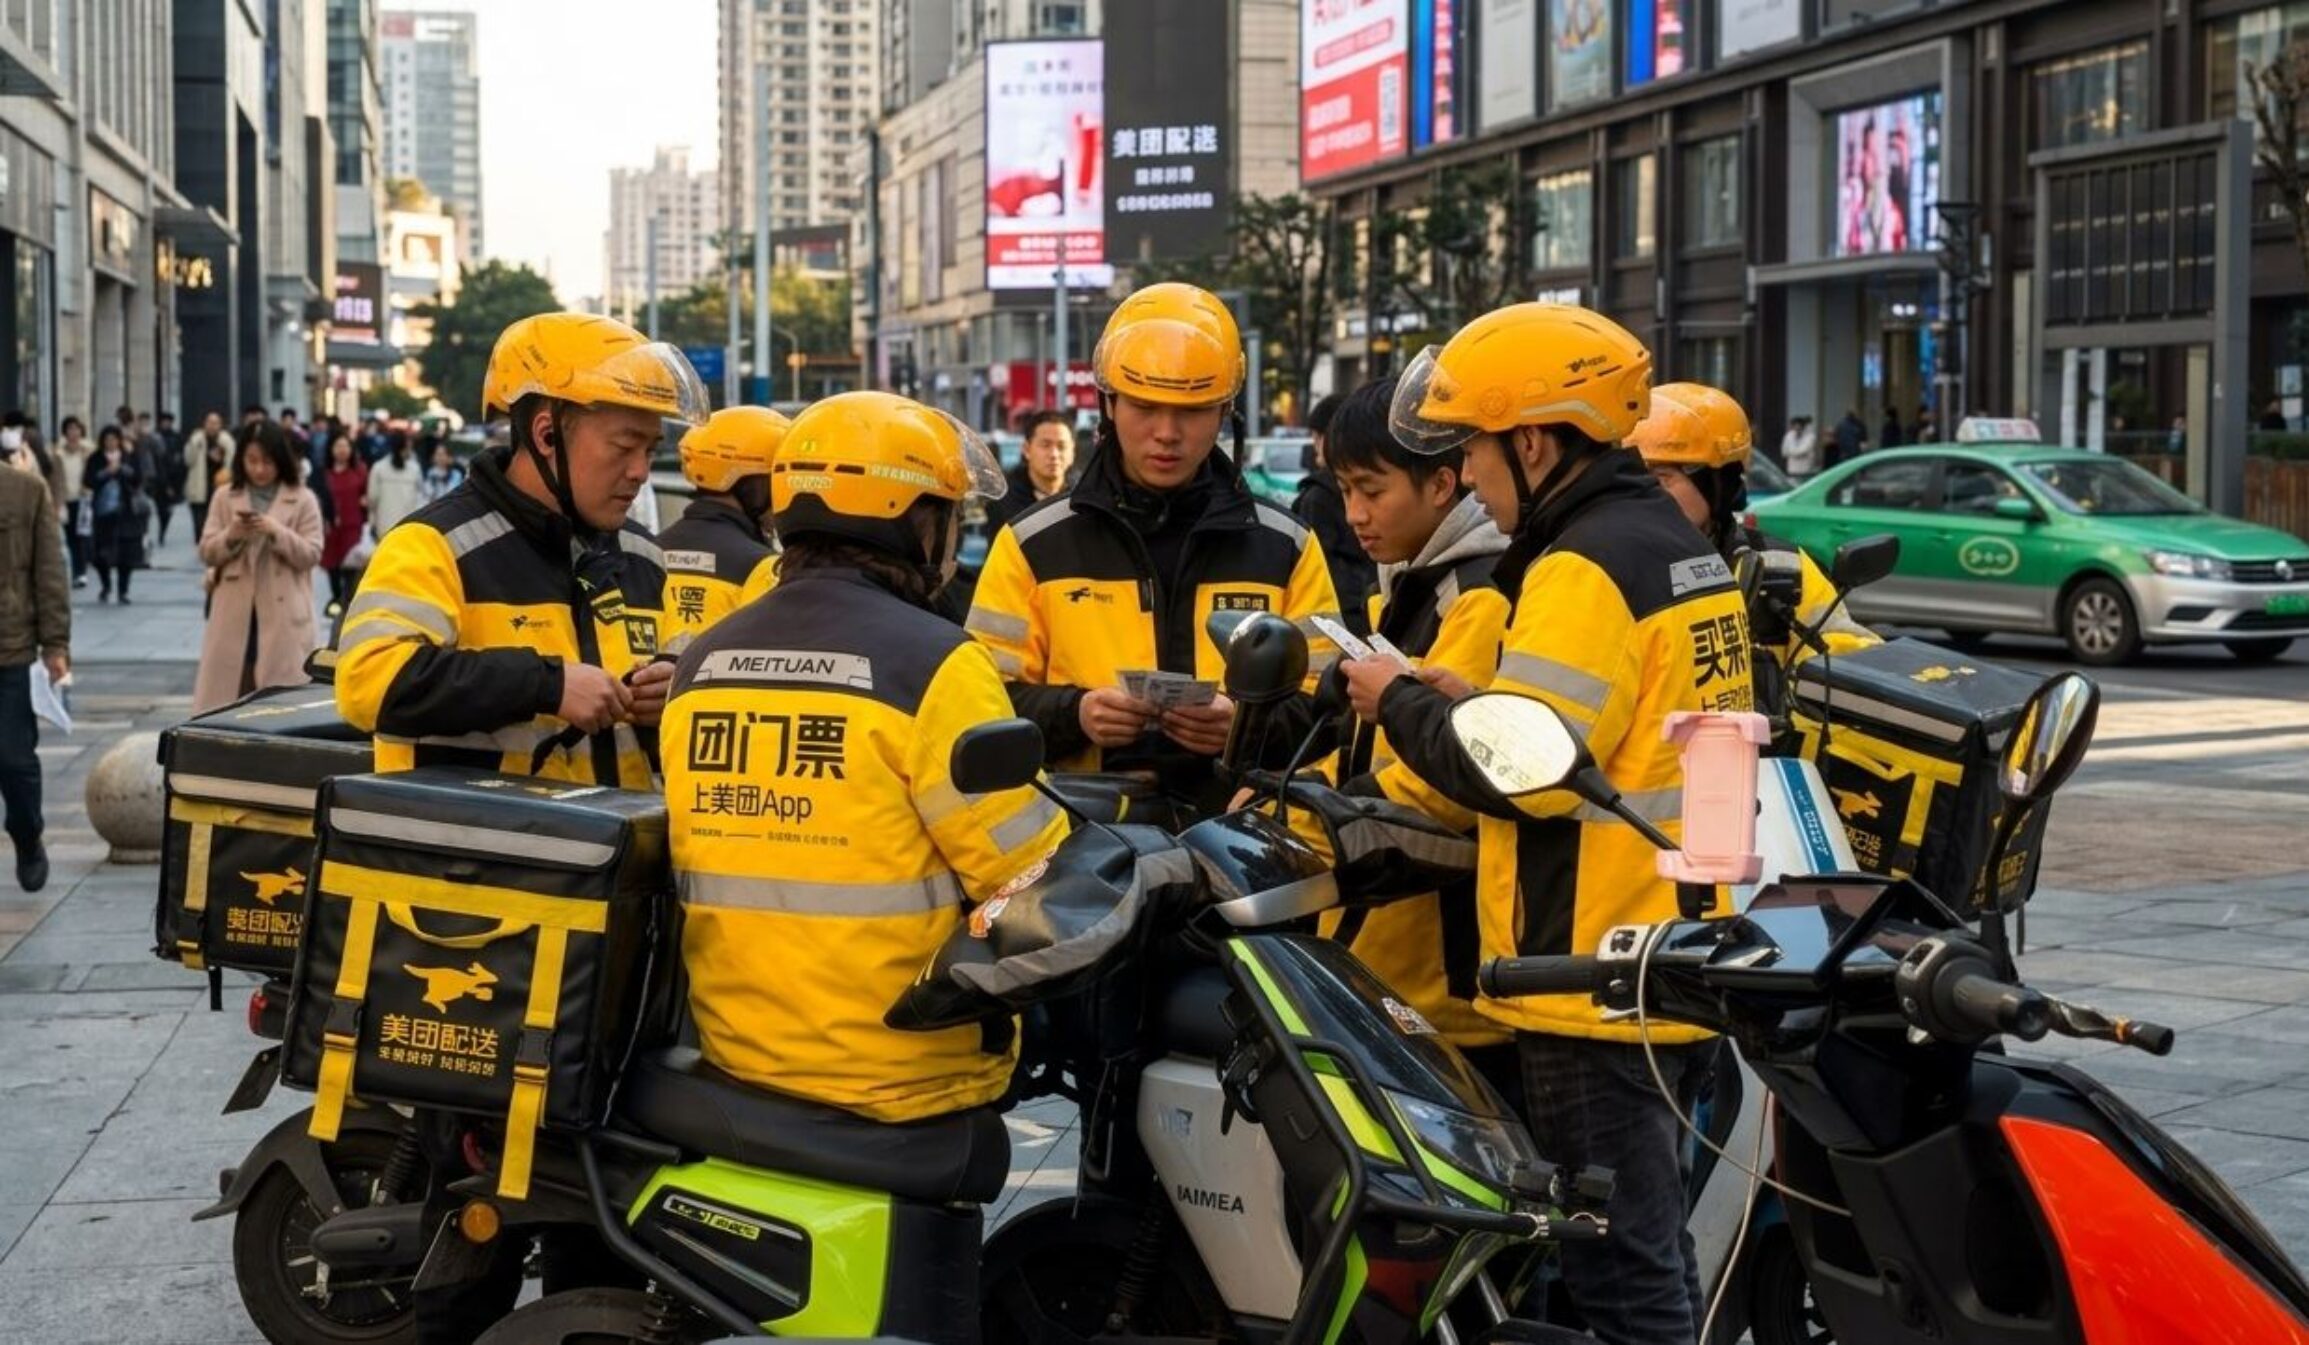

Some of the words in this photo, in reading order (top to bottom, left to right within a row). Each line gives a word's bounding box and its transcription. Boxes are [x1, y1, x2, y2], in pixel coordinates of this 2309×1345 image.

[670, 586, 706, 624] 票
[728, 656, 836, 675] MEITUAN
[688, 711, 848, 780] 团门票
[691, 781, 813, 825] 上美团App
[380, 1012, 499, 1059] 美团配送
